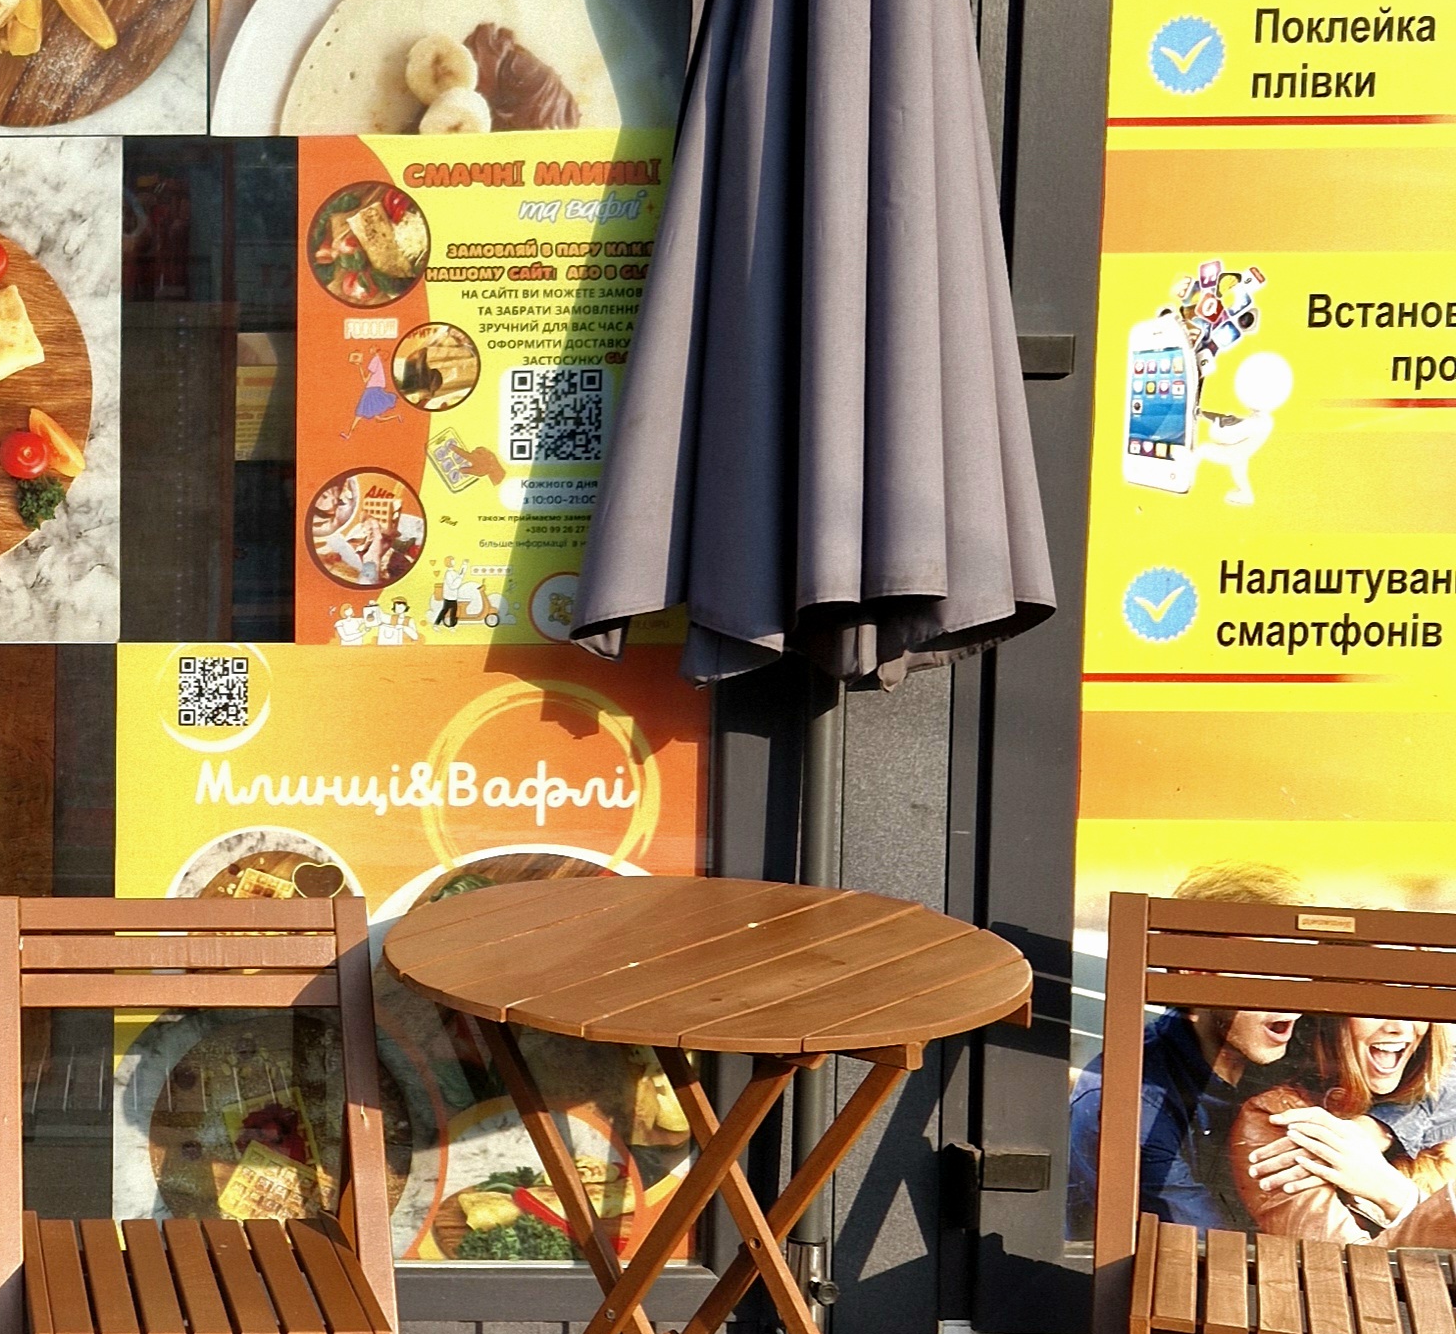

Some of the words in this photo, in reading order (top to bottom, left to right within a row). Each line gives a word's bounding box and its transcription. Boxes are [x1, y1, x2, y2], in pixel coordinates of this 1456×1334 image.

[1255, 6, 1436, 43] Поклейка
[1251, 63, 1376, 99] плівки
[404, 160, 525, 187] СМАЧНІ
[518, 199, 561, 221] та
[565, 192, 645, 224] вафлі
[446, 238, 538, 258] ЗАМОВЛЯЙ
[541, 242, 553, 258] В
[556, 241, 602, 258] ПАРУ
[425, 266, 504, 282] НАШОМУ
[566, 265, 602, 281] АБО
[461, 290, 478, 300] НА
[481, 287, 518, 299] САЙТІ
[522, 289, 539, 299] ВИ
[543, 288, 595, 299] МОЖЕТЕ
[478, 306, 492, 316] ТА
[496, 305, 551, 316] ЗАБРАТИ
[478, 320, 539, 333] ЗРУЧНИЙ
[542, 322, 567, 334] ДЛЯ
[570, 321, 595, 332] ВАС
[598, 321, 623, 332] ЧАС
[487, 339, 562, 350] ОФОРМИТИ
[565, 338, 631, 350] ДОСТАВКУ
[522, 355, 603, 366] ЗАСТОСУНКУ
[521, 479, 573, 489] Кожного
[576, 479, 598, 490] дня
[1219, 561, 1456, 603] Налаштуван
[1217, 613, 1442, 655] смартфонів
[195, 760, 641, 826] Млинці&Вафлі
